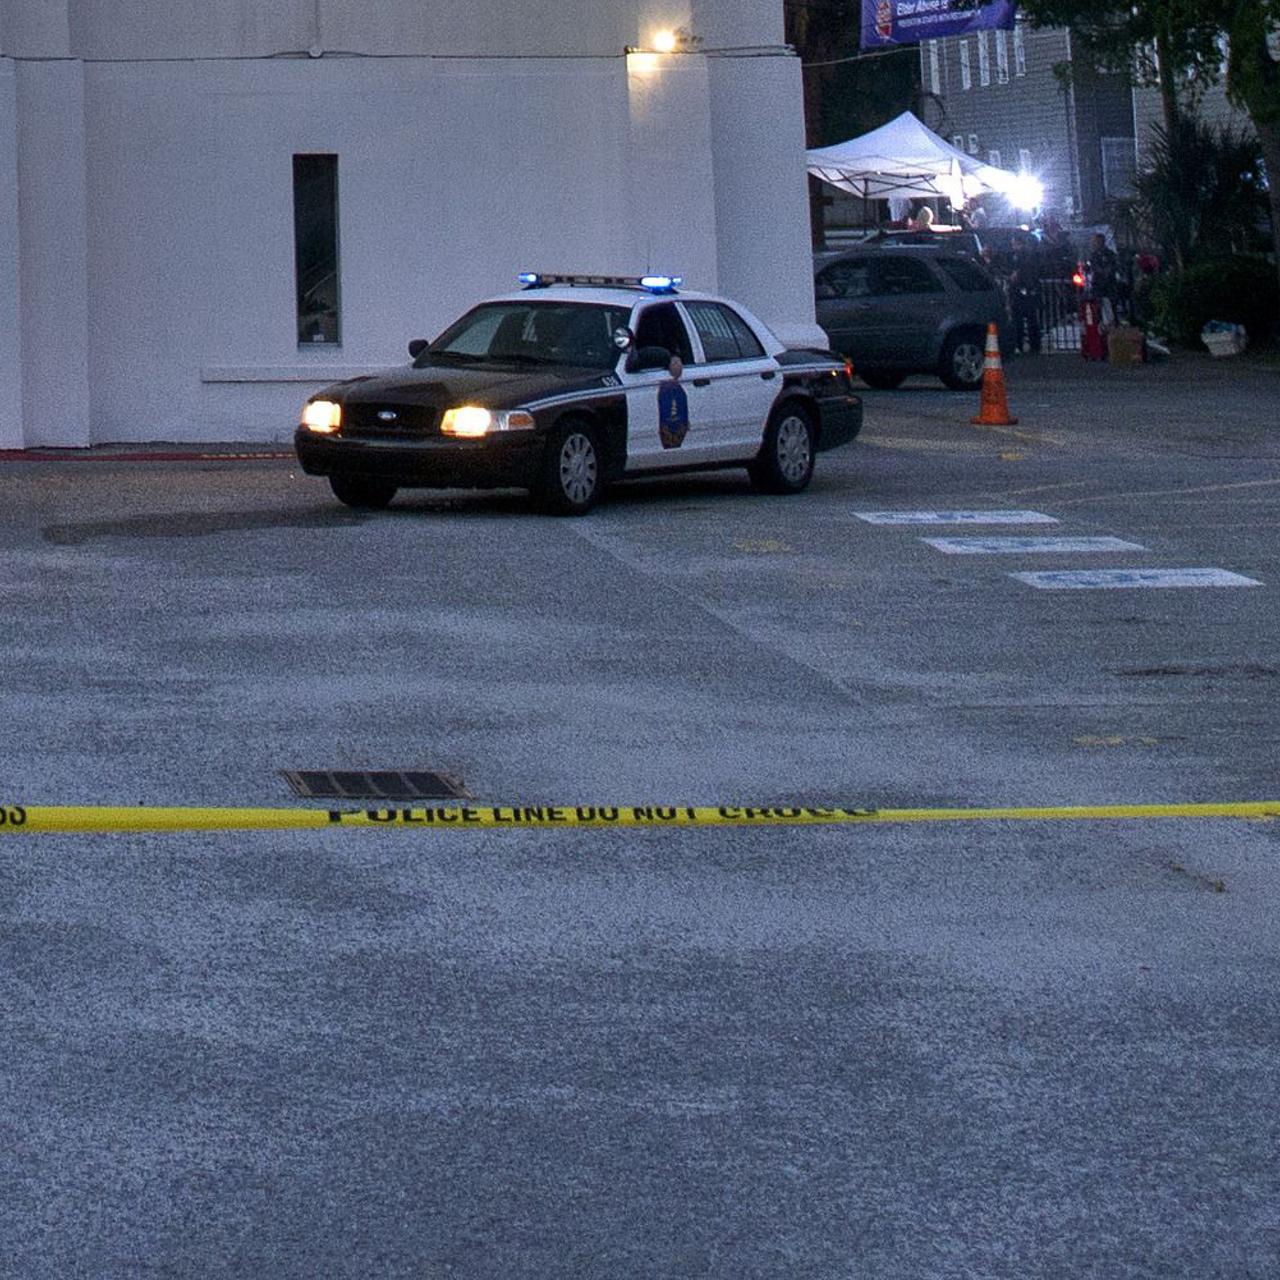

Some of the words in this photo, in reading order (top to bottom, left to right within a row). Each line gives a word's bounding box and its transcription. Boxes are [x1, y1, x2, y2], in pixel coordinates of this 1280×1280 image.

[329, 807, 481, 822] POLICE
[494, 807, 567, 821] LINE
[576, 808, 619, 821] DO
[633, 808, 699, 820] NOT
